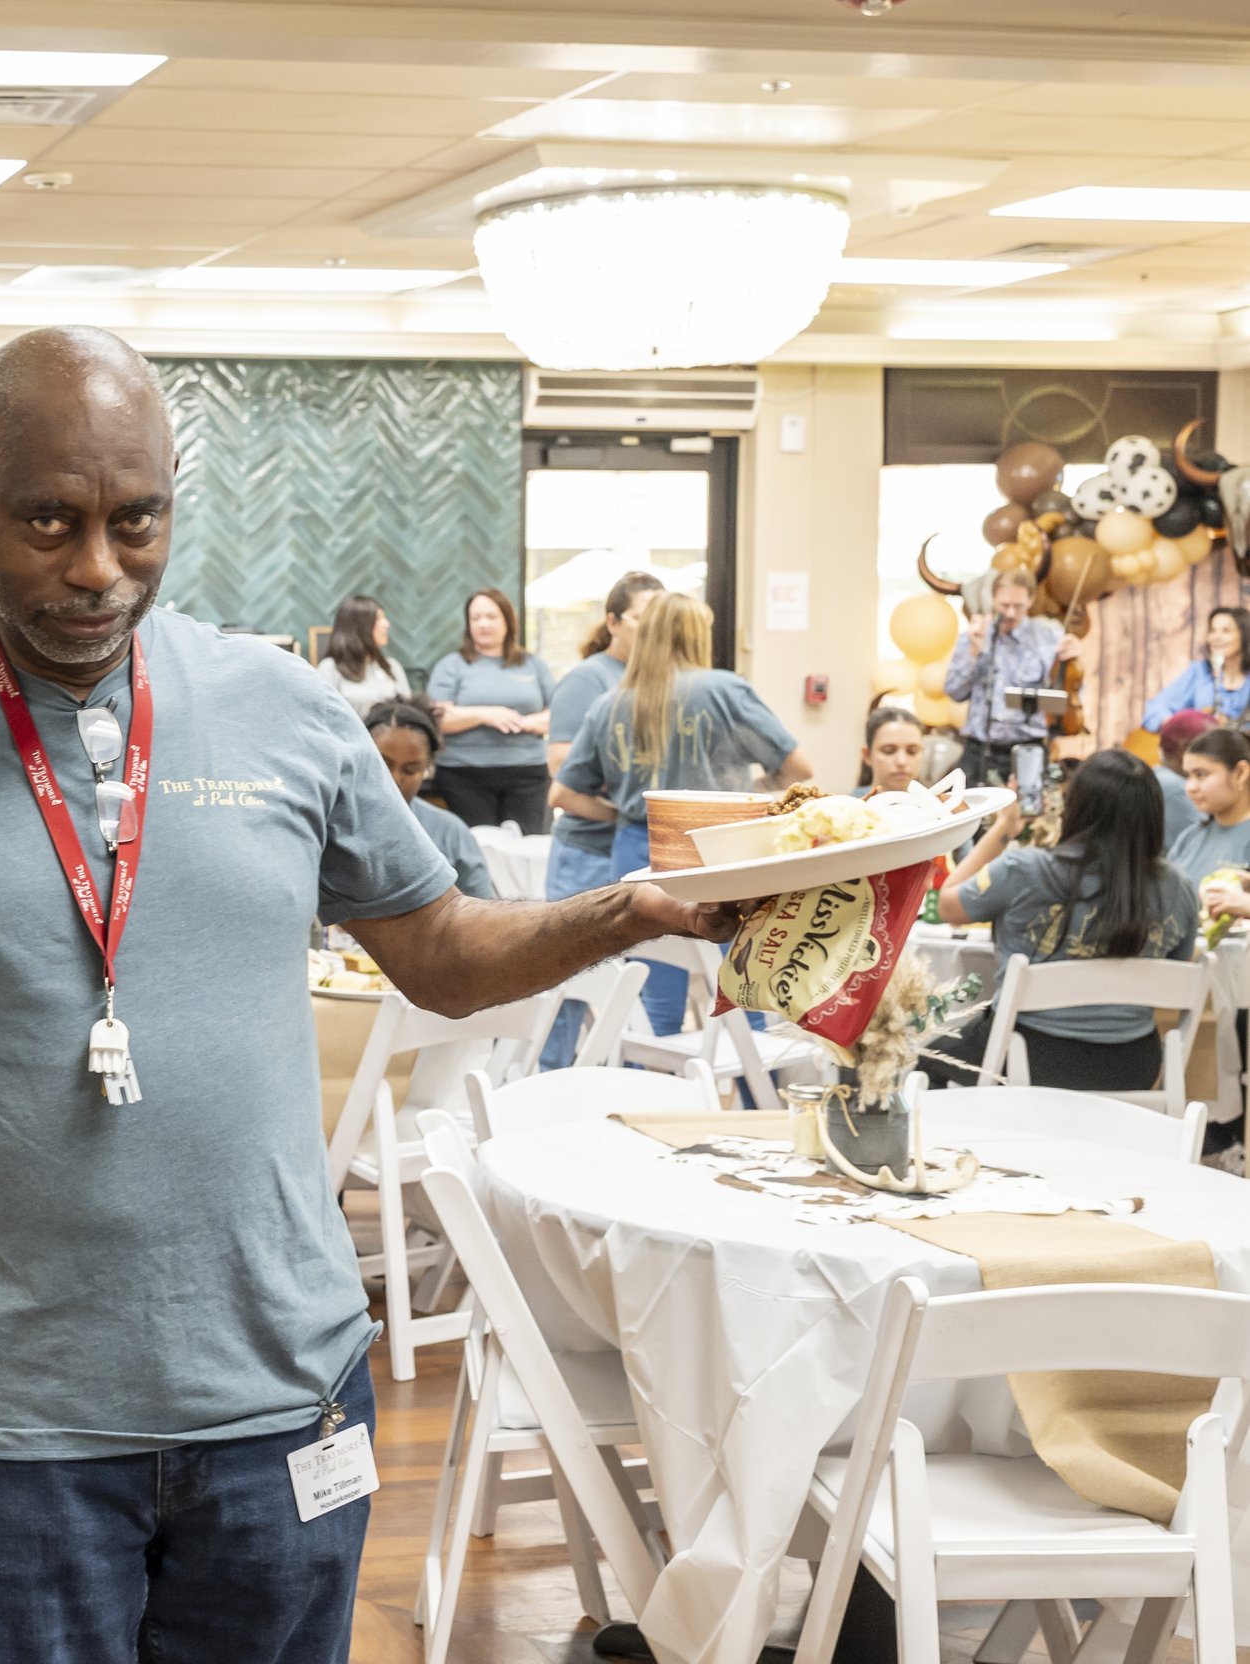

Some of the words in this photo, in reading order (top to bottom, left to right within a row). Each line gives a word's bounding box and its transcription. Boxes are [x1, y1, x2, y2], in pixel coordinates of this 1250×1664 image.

[158, 779, 193, 794] THE
[194, 777, 275, 792] TRAYMORE
[776, 891, 806, 920] SEA
[759, 927, 788, 969] SALT
[769, 926, 840, 1014] Vickie's
[313, 1488, 332, 1500] Mike
[333, 1475, 363, 1491] Tillman
